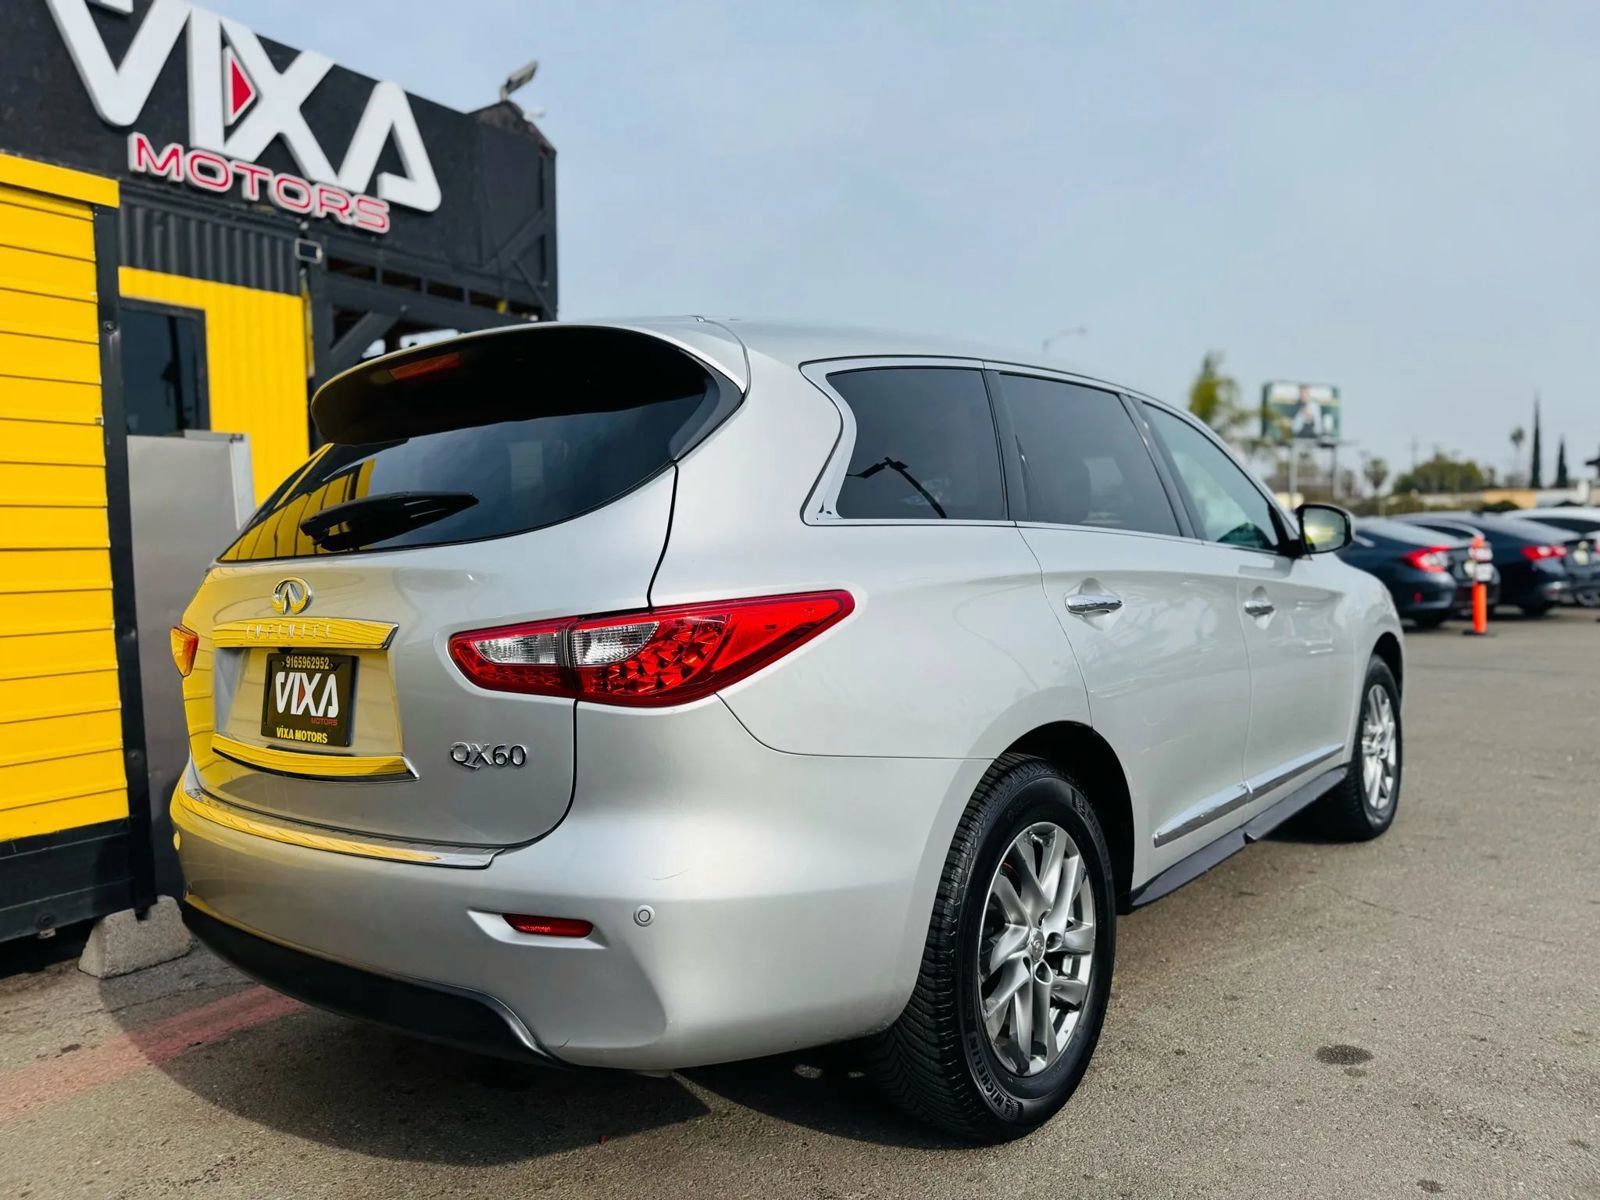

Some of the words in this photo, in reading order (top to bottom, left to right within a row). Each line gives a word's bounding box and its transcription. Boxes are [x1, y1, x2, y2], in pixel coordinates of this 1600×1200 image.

[46, 0, 442, 213] VIXA
[128, 131, 390, 235] MOTORS
[285, 655, 330, 670] 9165962952
[275, 671, 339, 718] VIXA
[294, 730, 329, 744] MOTORS
[310, 717, 338, 727] MOTORS
[450, 741, 527, 770] QX60
[968, 1035, 1006, 1107] MICHELIN
